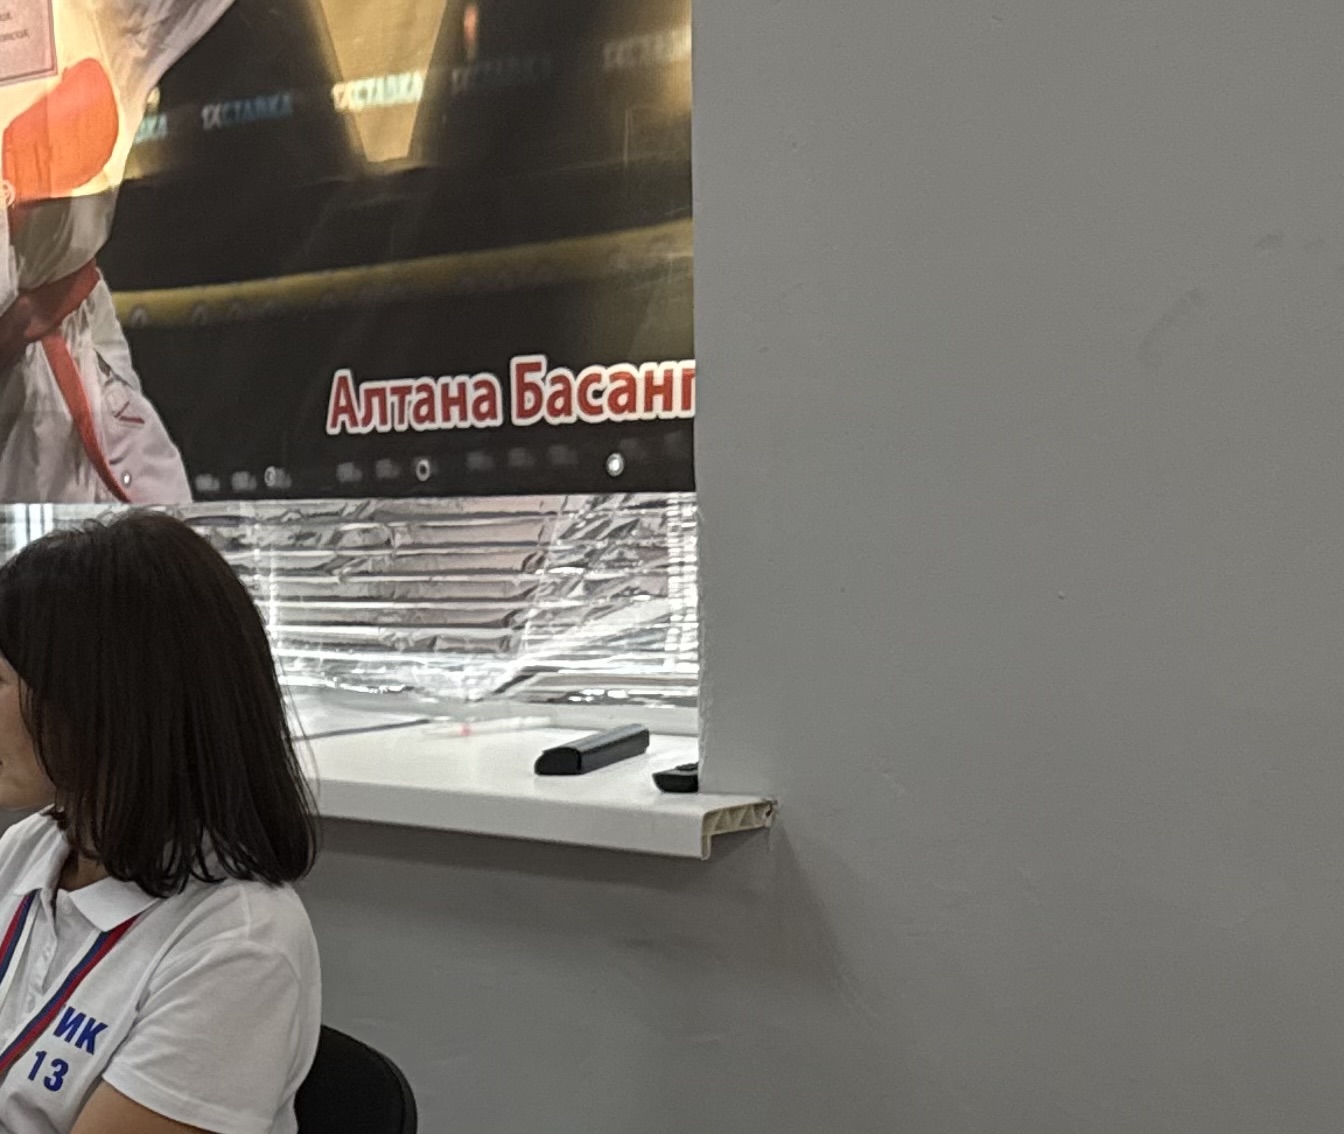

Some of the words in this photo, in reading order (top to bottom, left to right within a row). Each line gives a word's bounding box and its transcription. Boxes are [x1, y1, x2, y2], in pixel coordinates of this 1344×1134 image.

[326, 369, 502, 434] Алтана
[53, 1004, 109, 1056] ИК
[28, 1050, 69, 1092] 13
